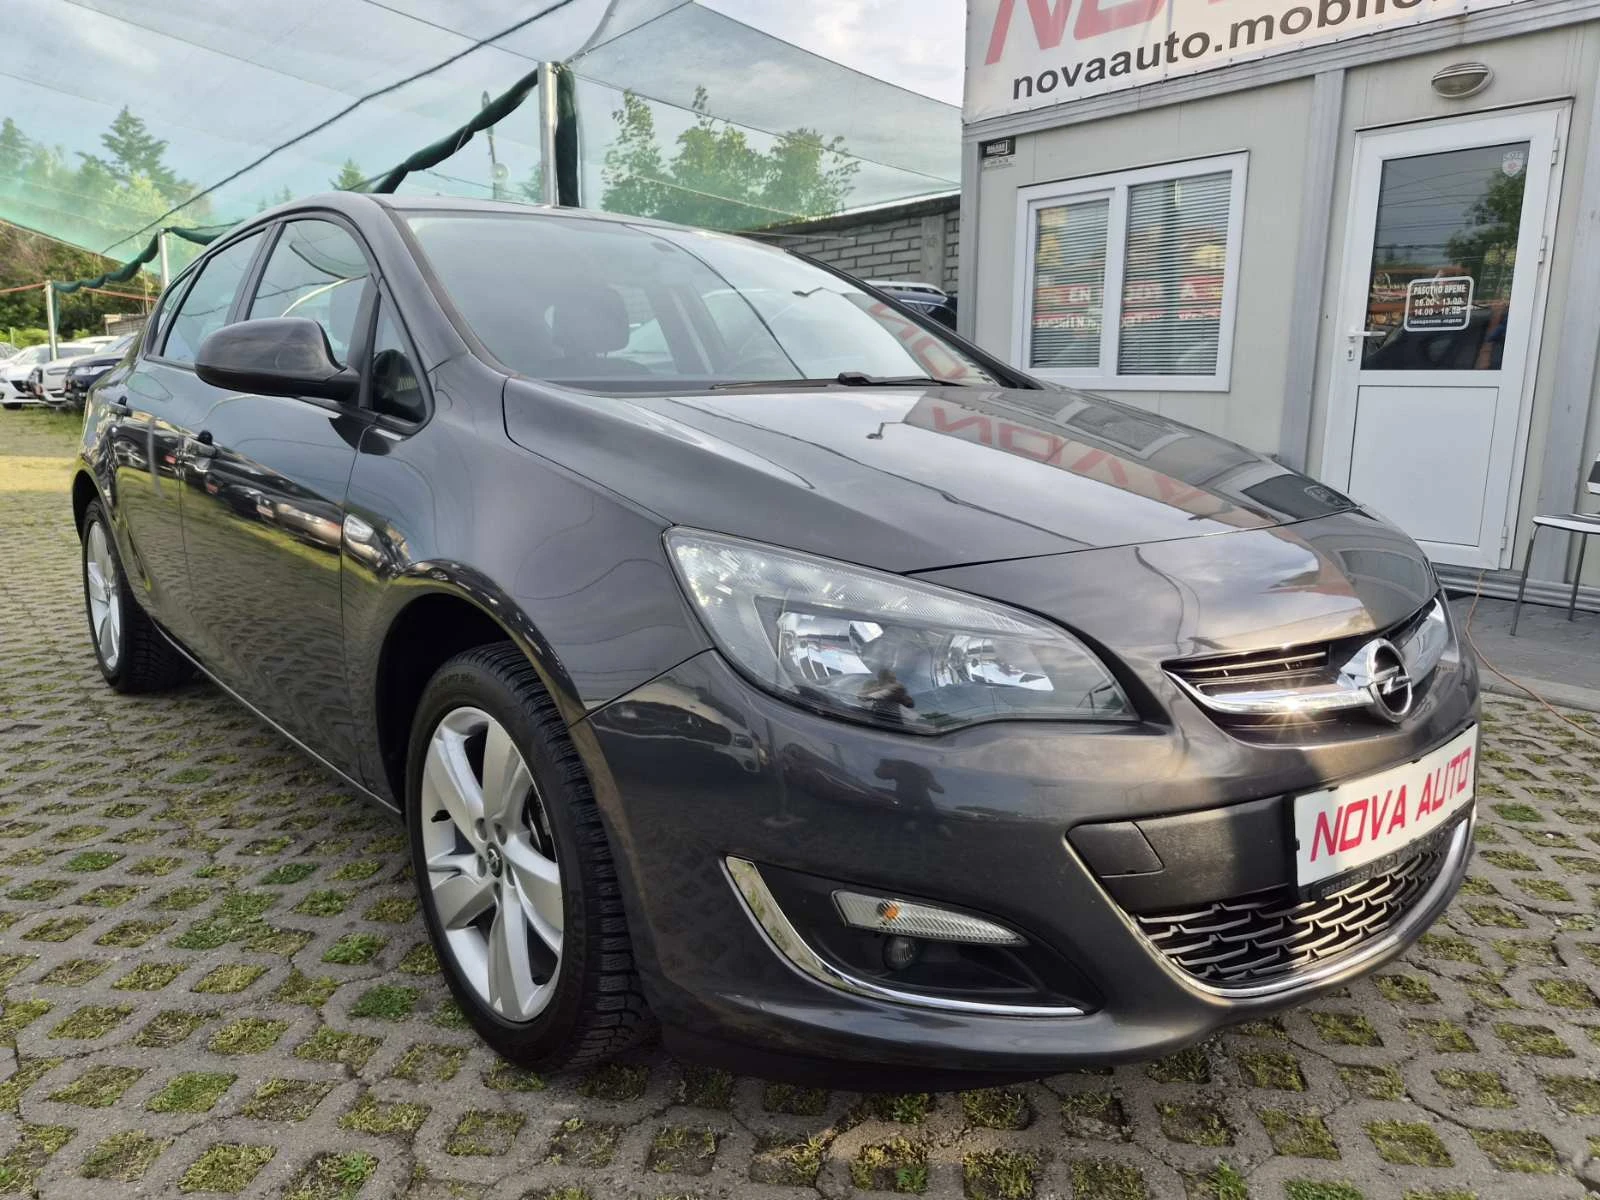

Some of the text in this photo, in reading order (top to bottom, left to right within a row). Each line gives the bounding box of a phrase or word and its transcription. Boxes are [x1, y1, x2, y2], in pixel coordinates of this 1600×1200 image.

[1012, 0, 1438, 100] novaauto.mobi
[1310, 746, 1472, 862] NOVA AUTO
